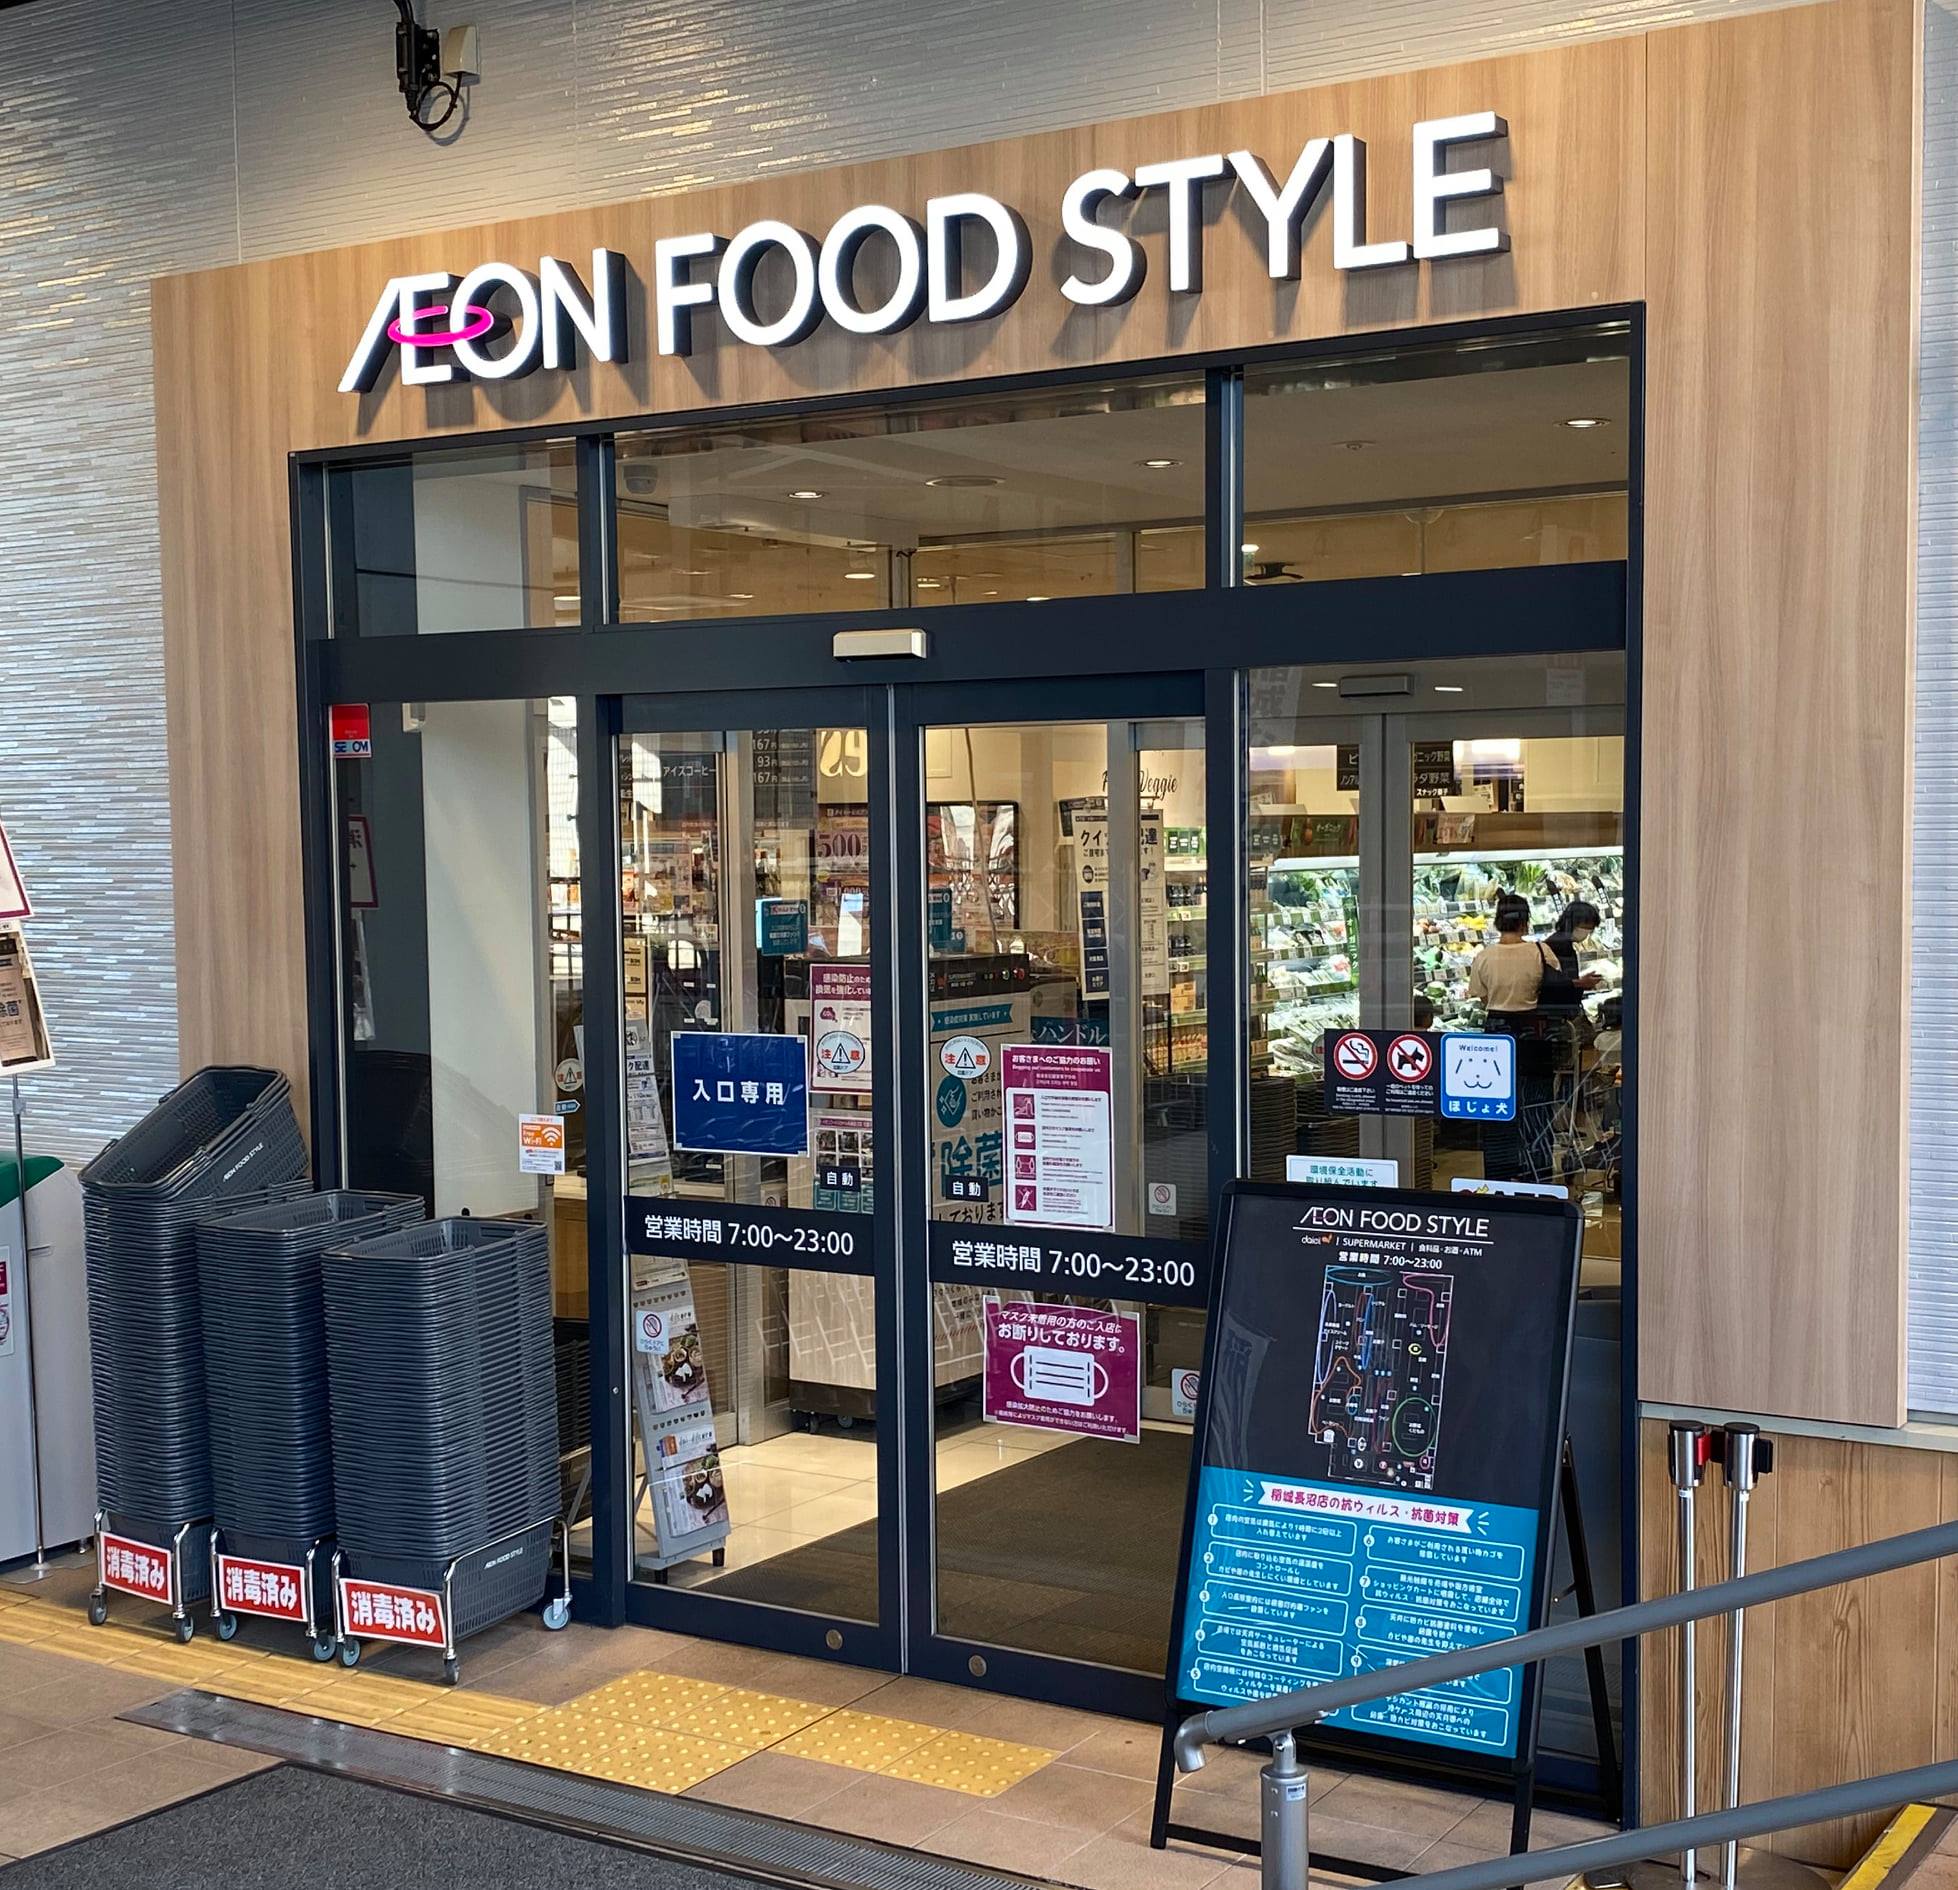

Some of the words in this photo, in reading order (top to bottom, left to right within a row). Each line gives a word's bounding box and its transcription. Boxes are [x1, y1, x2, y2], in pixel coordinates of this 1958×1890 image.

[655, 193, 1030, 356] FOOD
[1061, 111, 1509, 306] STYLE
[1081, 829, 1108, 846] クイ
[1032, 1022, 1108, 1044] ハンドル
[1459, 1044, 1498, 1052] Welcome!
[692, 1079, 785, 1105] 入口専用
[1449, 1100, 1508, 1115] ほじょ犬
[235, 1155, 250, 1170] FOOD
[249, 1142, 265, 1157] STYLE
[826, 1171, 854, 1187] 自動
[1309, 1164, 1374, 1178] 環境保全活動に
[952, 1181, 981, 1197] 自動
[644, 1214, 722, 1245] 営業時間
[1360, 1209, 1422, 1232] FOOD
[1426, 1215, 1490, 1237] STYLE
[952, 1240, 1041, 1273] 営業時間
[1343, 1237, 1406, 1251] SUPERMARKET
[1338, 1251, 1380, 1265] 営業時間
[997, 1322, 1126, 1354] お断りしております。
[1270, 1487, 1460, 1528] 稲城長沼店の抗ウィルス・抗菌対策
[105, 1545, 167, 1592] 消毒済み
[225, 1566, 298, 1610] 消毒済み
[351, 1590, 437, 1636] 消毒済み
